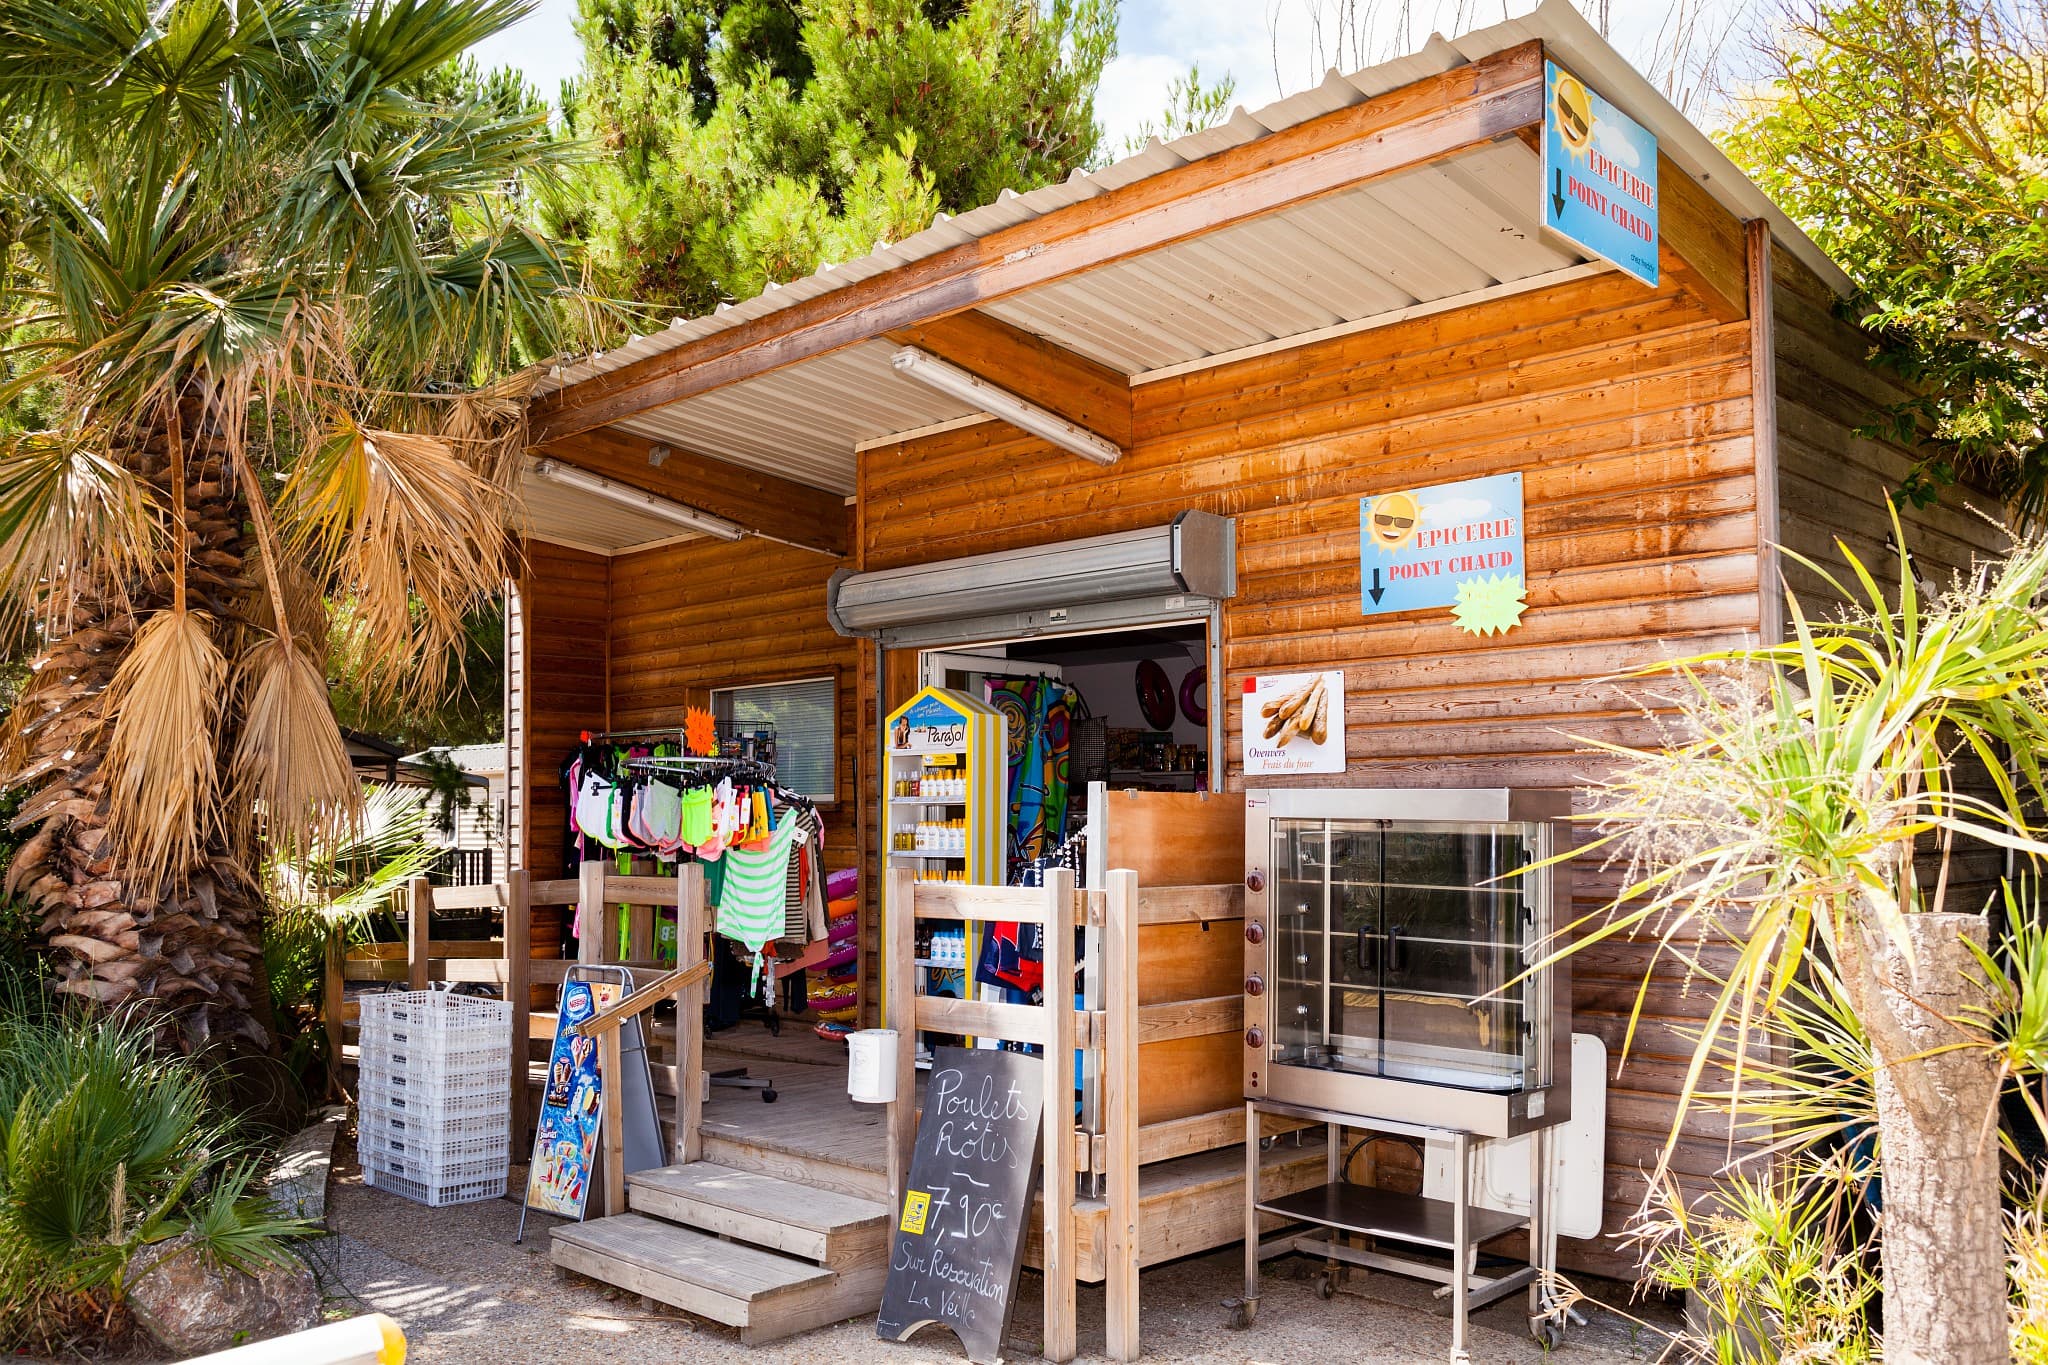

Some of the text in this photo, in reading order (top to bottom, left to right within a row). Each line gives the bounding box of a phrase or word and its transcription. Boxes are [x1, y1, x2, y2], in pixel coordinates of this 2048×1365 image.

[1589, 148, 1655, 209] EPICERIE
[1568, 175, 1653, 243] POINT CHAUD
[1416, 517, 1517, 550] EPICERIE
[1389, 551, 1513, 581] POINT CHAUD
[1262, 759, 1283, 769] Frais
[1283, 758, 1294, 769] du
[935, 1068, 1030, 1121] Poulets
[935, 1120, 1019, 1169] Rôtis
[894, 1240, 927, 1273] Sur
[907, 1279, 976, 1329] La Veille
